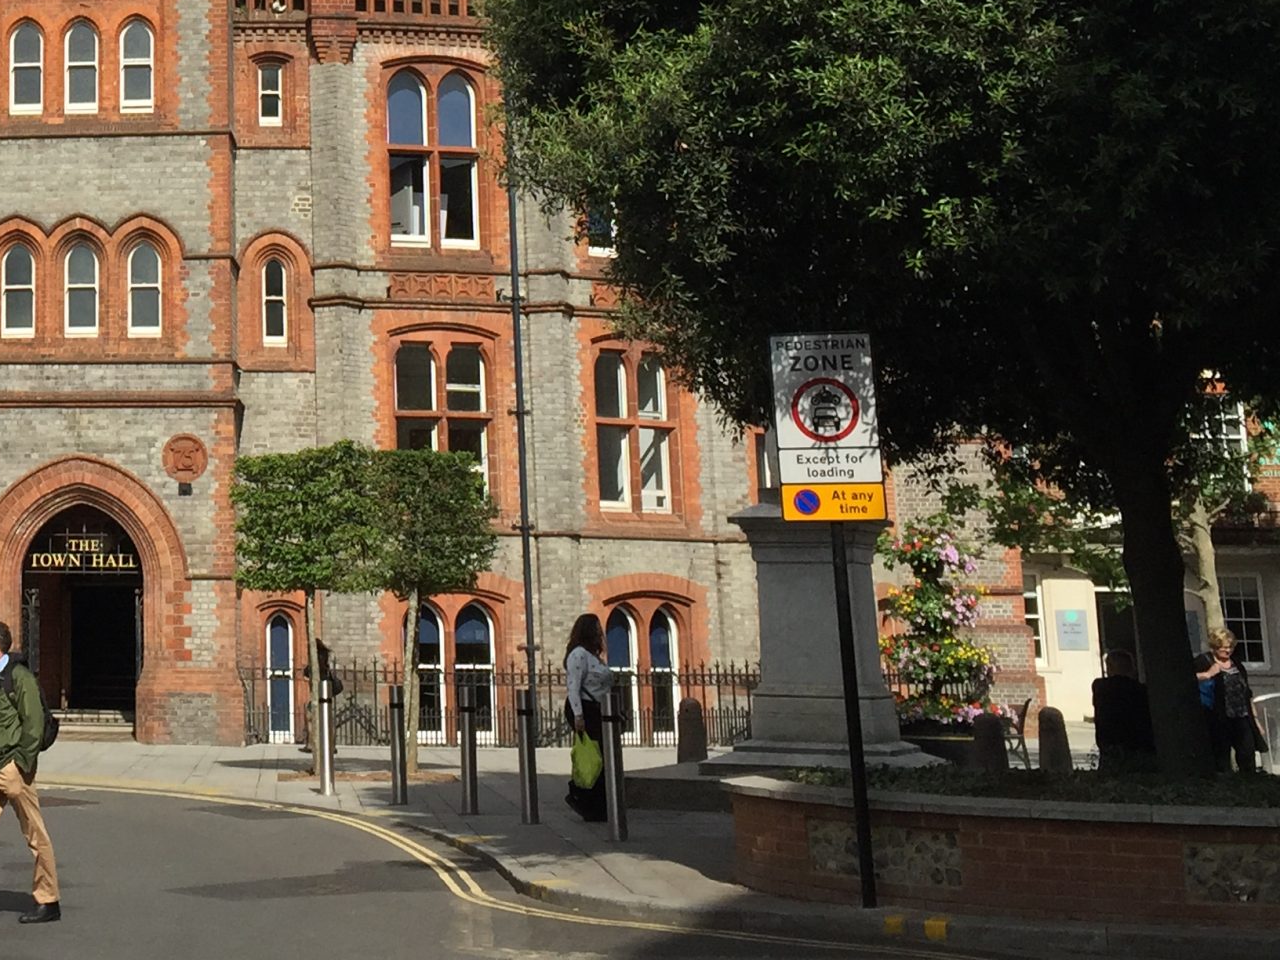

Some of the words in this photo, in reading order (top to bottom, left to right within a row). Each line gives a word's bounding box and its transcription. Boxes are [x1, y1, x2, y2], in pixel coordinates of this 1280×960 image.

[776, 338, 866, 351] PEDESTRIAN
[790, 354, 854, 371] ZONE
[796, 454, 840, 465] Except
[845, 454, 864, 464] for
[807, 467, 855, 478] loading
[832, 490, 847, 500] At
[851, 492, 874, 501] any
[839, 503, 868, 514] time
[68, 539, 100, 551] THE
[31, 553, 81, 567] TOWN
[92, 553, 138, 567] HALL
